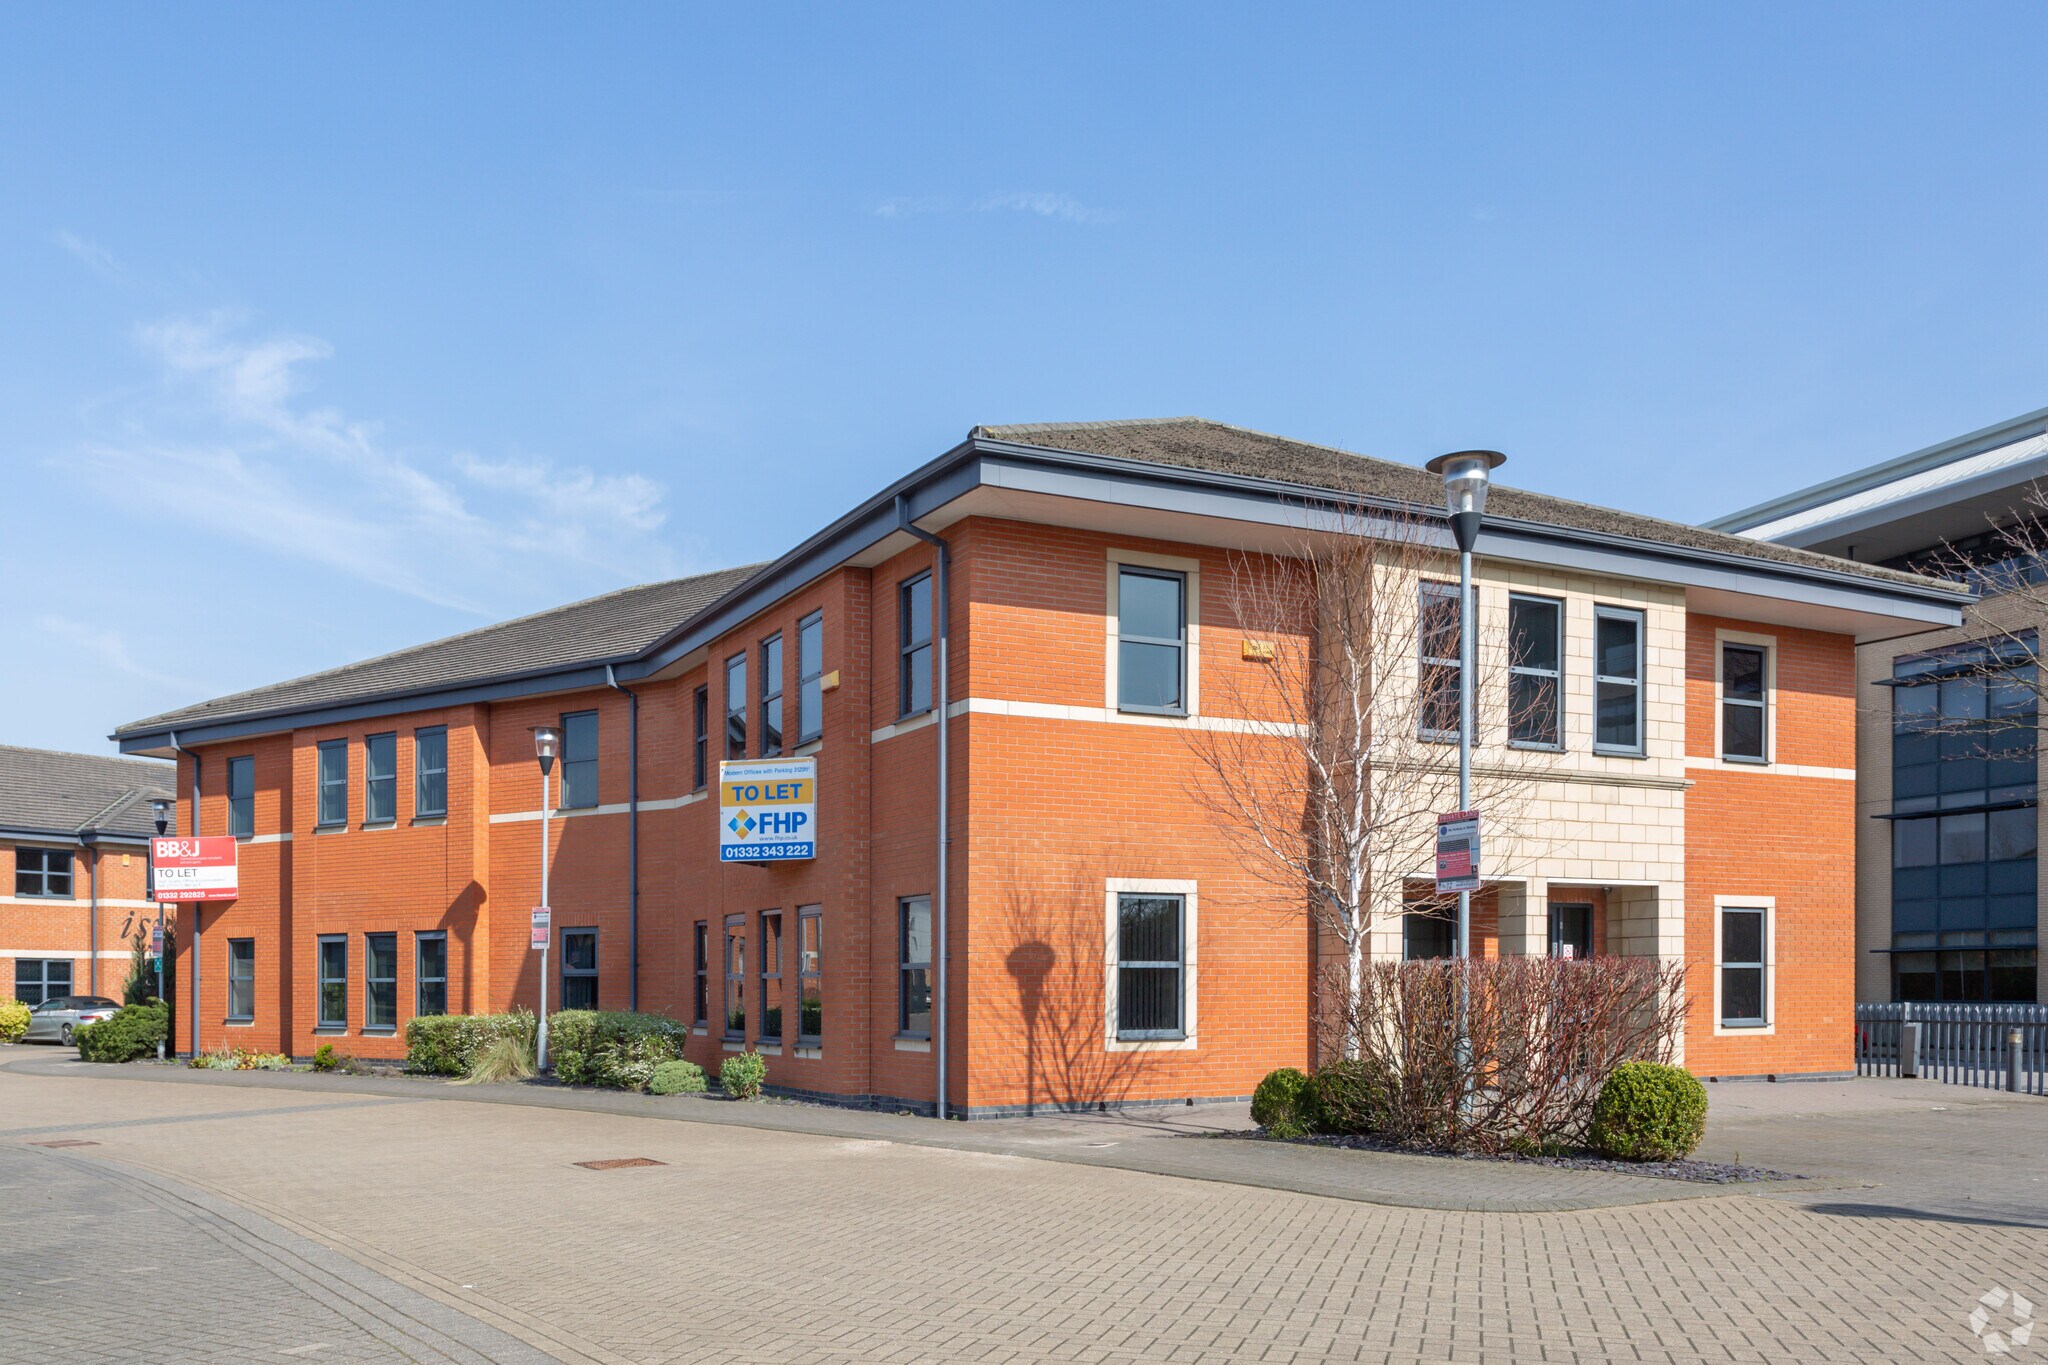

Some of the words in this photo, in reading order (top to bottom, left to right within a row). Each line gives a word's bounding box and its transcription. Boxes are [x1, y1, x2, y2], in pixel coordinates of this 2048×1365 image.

[774, 766, 793, 775] Parking
[731, 785, 759, 802] TO
[764, 783, 803, 800] LET
[759, 811, 807, 834] FHP
[1439, 812, 1461, 821] PRIVATE
[156, 840, 200, 858] BB&J
[725, 847, 760, 858] 01332
[762, 845, 784, 856] 343
[786, 844, 808, 856] 222
[158, 869, 174, 878] TO
[177, 868, 198, 878] LET
